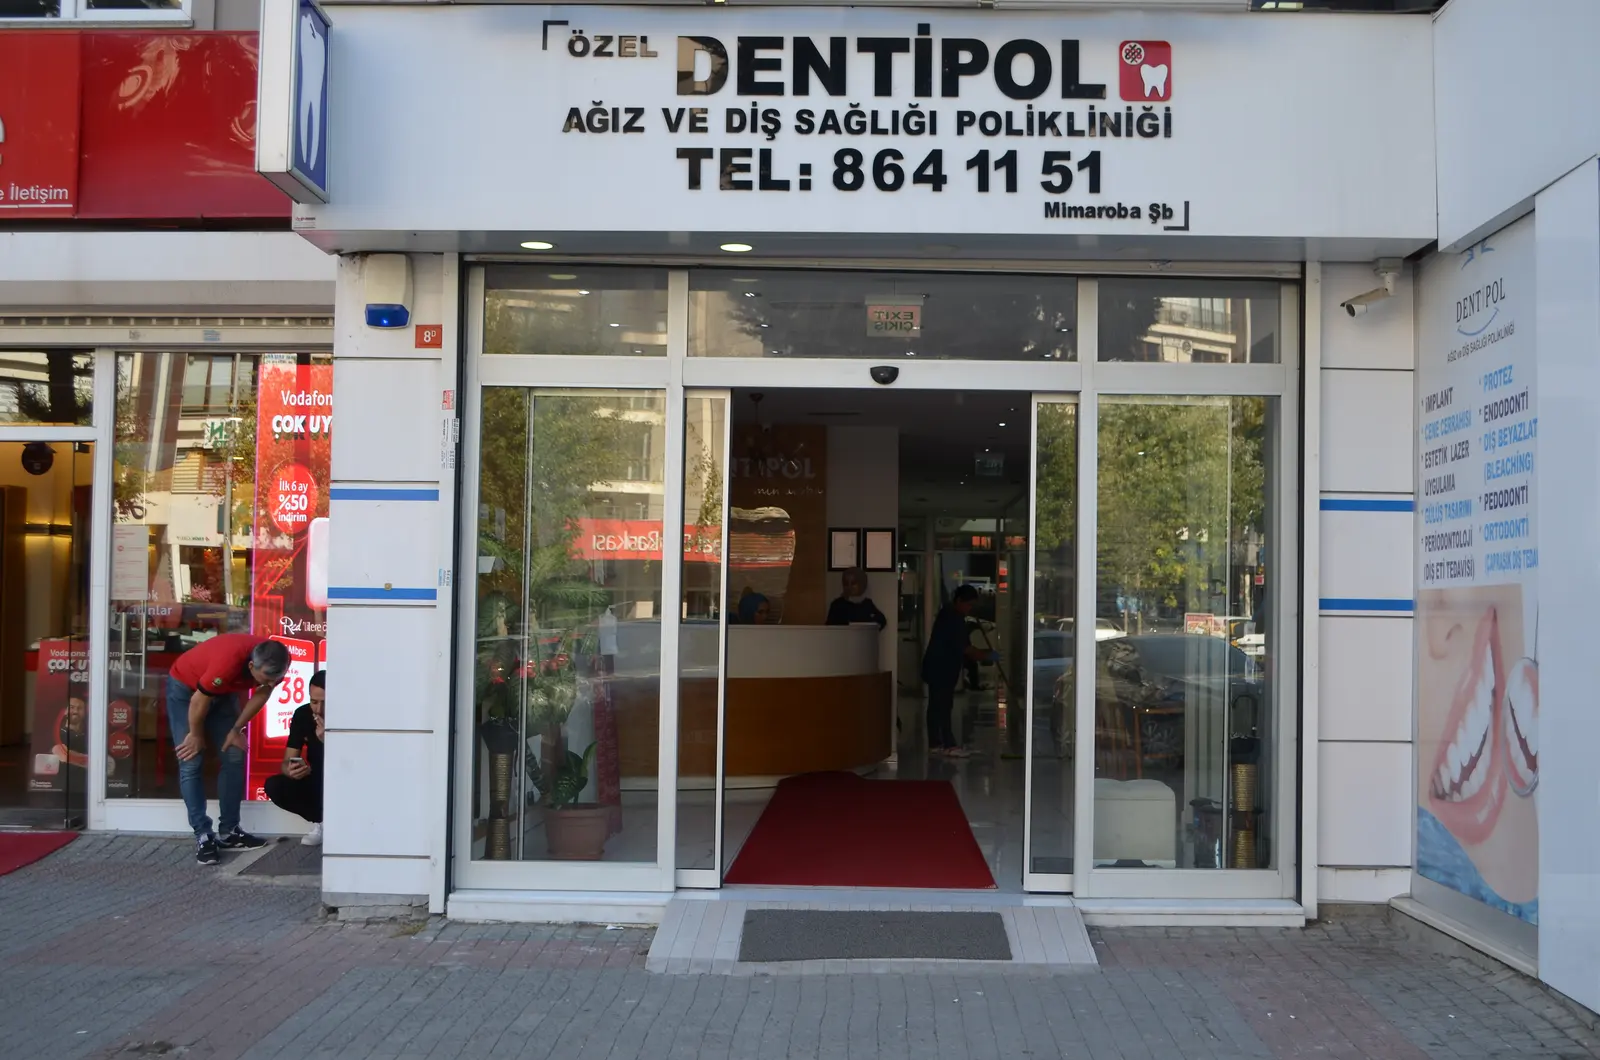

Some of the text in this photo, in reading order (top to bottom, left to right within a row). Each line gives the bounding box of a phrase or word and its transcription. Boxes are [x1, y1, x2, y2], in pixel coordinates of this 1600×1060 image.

[567, 22, 1107, 100] ÖZEL DENTİPOL
[562, 100, 1172, 141] AĞIZ VE DİŞ SAĞLIĞI POLİKLİNİĞİ
[676, 147, 1101, 194] TEL: 864 11 51
[10, 182, 69, 204] İletişim
[1044, 202, 1173, 225] Mimaroba Şb
[1483, 364, 1513, 393] PROTEZ
[281, 389, 333, 406] Vodafon
[1483, 386, 1529, 423] ENDODONTİ
[271, 414, 333, 440] ÇOK UY
[1483, 417, 1539, 454] DİŞ BEYAZLAT
[1424, 439, 1470, 470] ESTETİK LAZER
[279, 477, 309, 494] İlk 6 ay
[1424, 472, 1456, 497] UYGULAMA
[1483, 480, 1529, 512] PEDODONTİ
[278, 493, 308, 512] %50
[277, 512, 308, 522] indirim
[1483, 513, 1530, 542] ORTODONTİ
[288, 644, 307, 658] Mbps
[278, 676, 305, 704] 38
